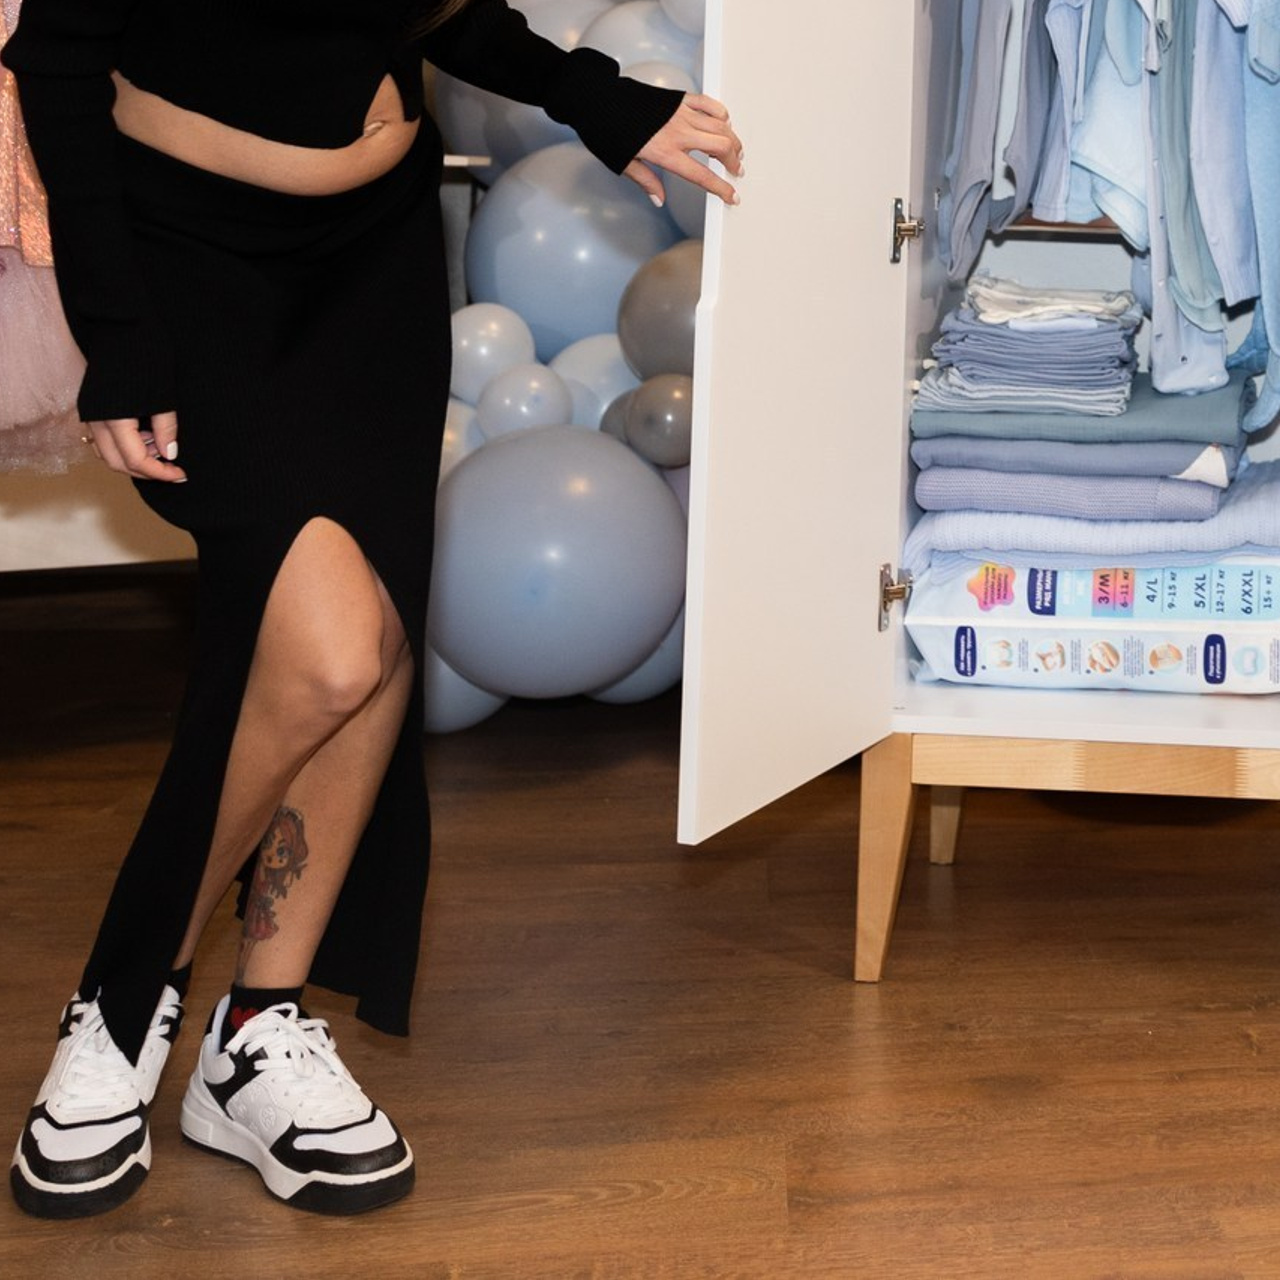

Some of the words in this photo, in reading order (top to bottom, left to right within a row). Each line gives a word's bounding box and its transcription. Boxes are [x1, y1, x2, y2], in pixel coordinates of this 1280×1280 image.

[1098, 573, 1111, 605] 3/M
[1120, 583, 1130, 608] 6-11
[1146, 578, 1158, 603] 4/L
[1167, 584, 1178, 610] 9-15
[1194, 574, 1206, 609] 5/XL
[1216, 583, 1226, 613] 12-17
[1241, 570, 1254, 615] 6/XXL
[1263, 590, 1273, 609] 15+
